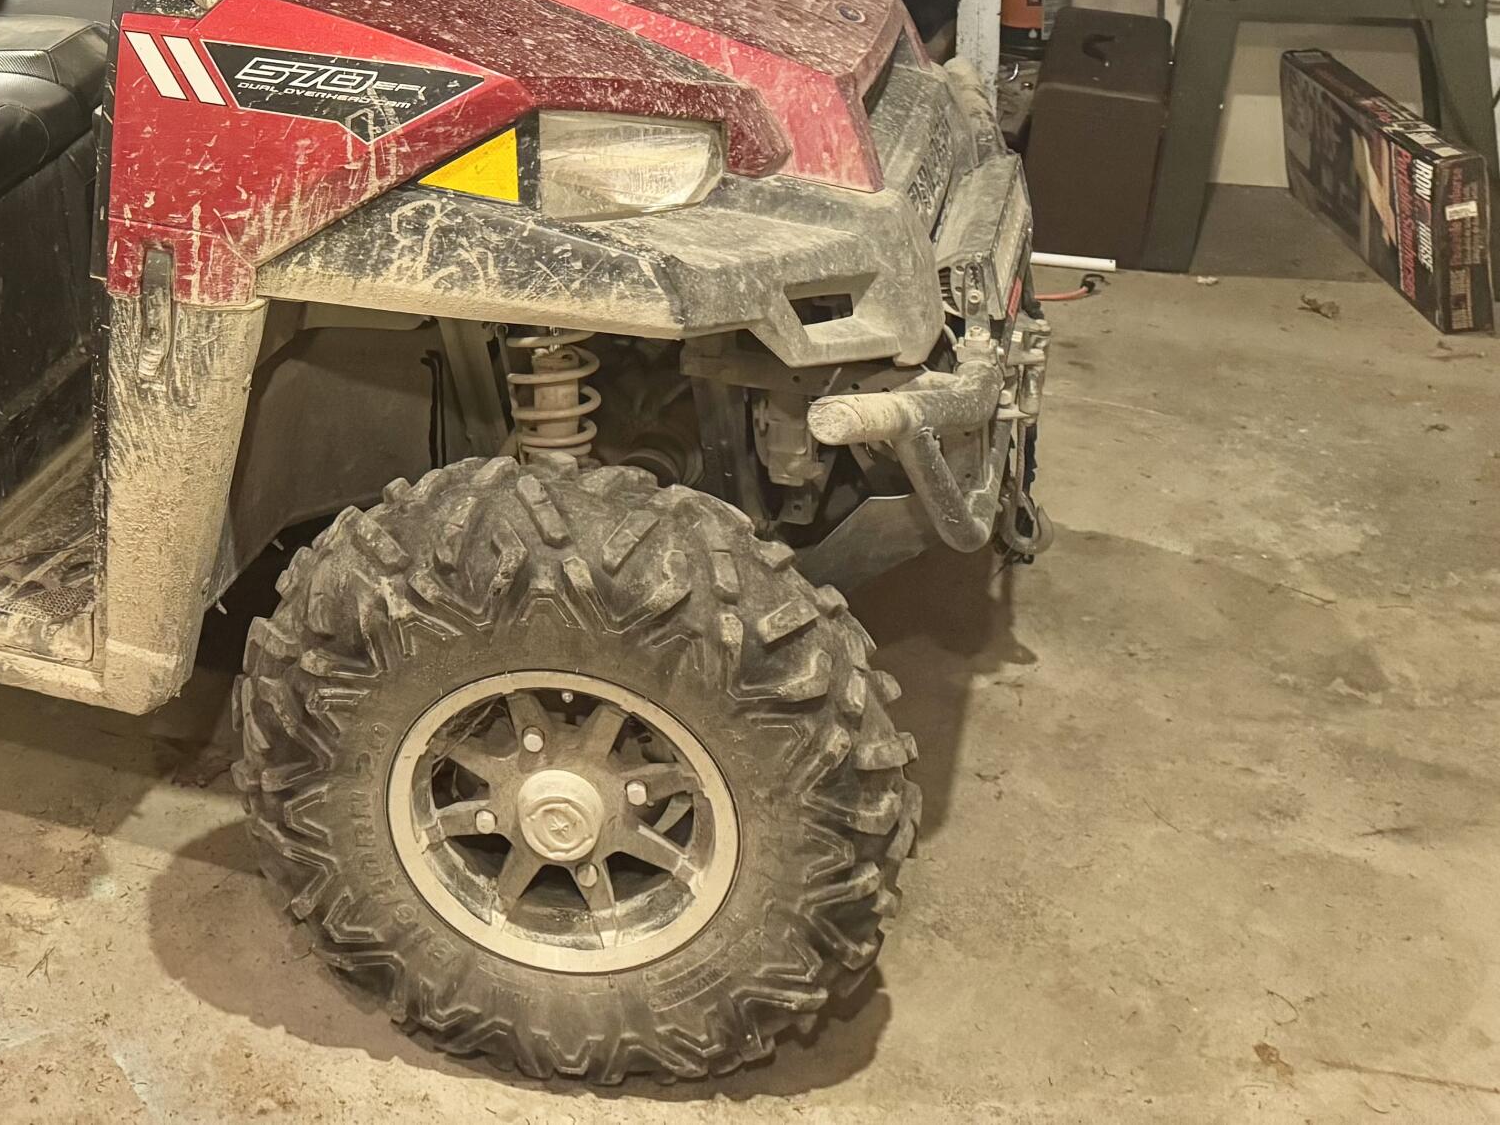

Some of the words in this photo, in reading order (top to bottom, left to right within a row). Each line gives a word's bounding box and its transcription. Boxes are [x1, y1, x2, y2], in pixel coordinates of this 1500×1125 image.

[234, 57, 378, 93] 570
[237, 81, 280, 93] DUAL
[283, 87, 372, 104] OVERHEAD
[374, 98, 413, 109] CAM
[1413, 158, 1434, 202] IRON
[1417, 220, 1434, 273] HORSE
